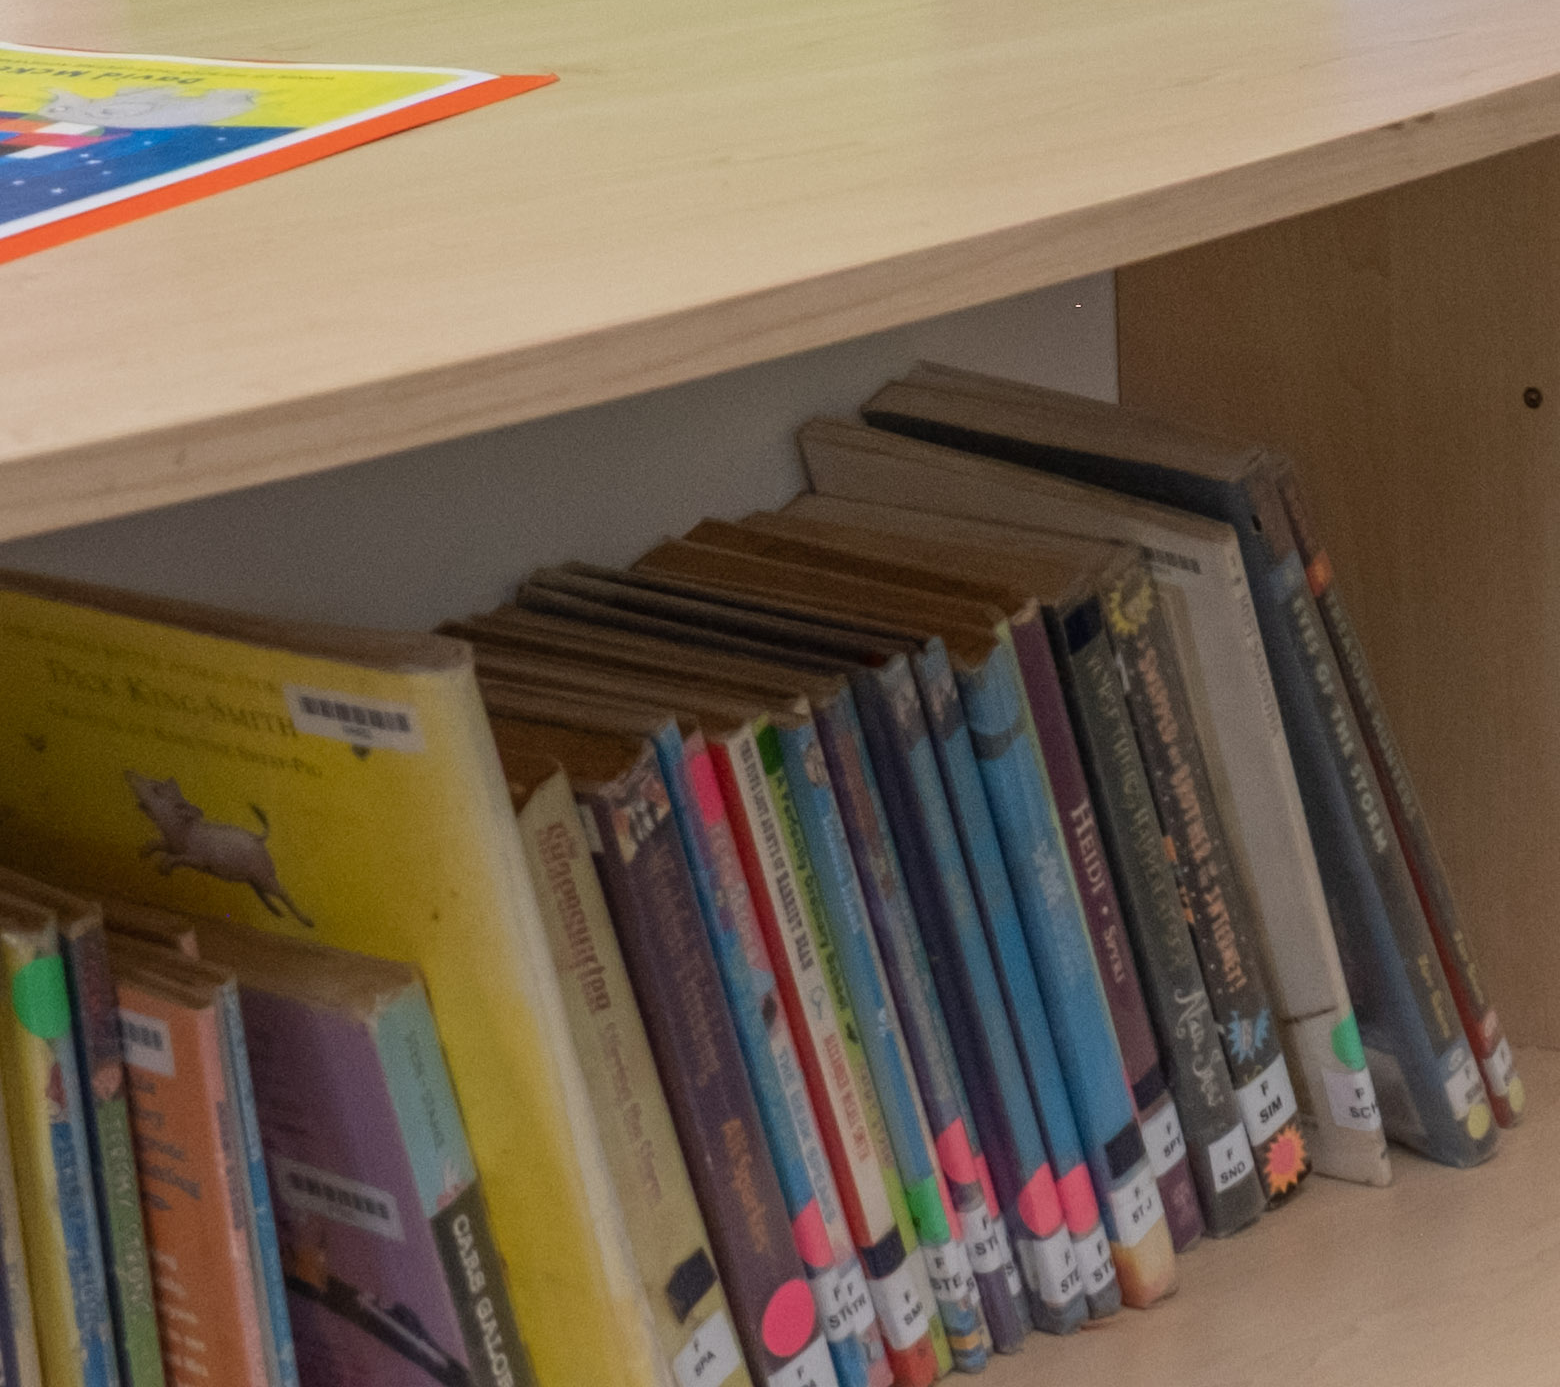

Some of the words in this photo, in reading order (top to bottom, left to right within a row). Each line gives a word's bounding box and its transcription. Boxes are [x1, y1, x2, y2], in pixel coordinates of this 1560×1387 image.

[104, 69, 205, 86] David
[1291, 595, 1319, 656] EYES
[1314, 662, 1334, 696] OF
[1329, 703, 1355, 759] THE
[1350, 763, 1387, 853] STORM
[1325, 591, 1374, 708] TREASURE
[1370, 713, 1416, 821] HUNTERS
[793, 933, 813, 971] BEAN
[1070, 799, 1109, 895] HEIDI
[1102, 924, 1128, 983] SPYRI
[775, 1045, 798, 1089] THE
[789, 1092, 814, 1147] BEAK
[806, 1149, 836, 1227] SPEAKS
[1259, 1096, 1283, 1124] SIM
[104, 1119, 133, 1208] JEREMY
[119, 1224, 151, 1321] STRONG
[452, 1213, 486, 1293] CARS
